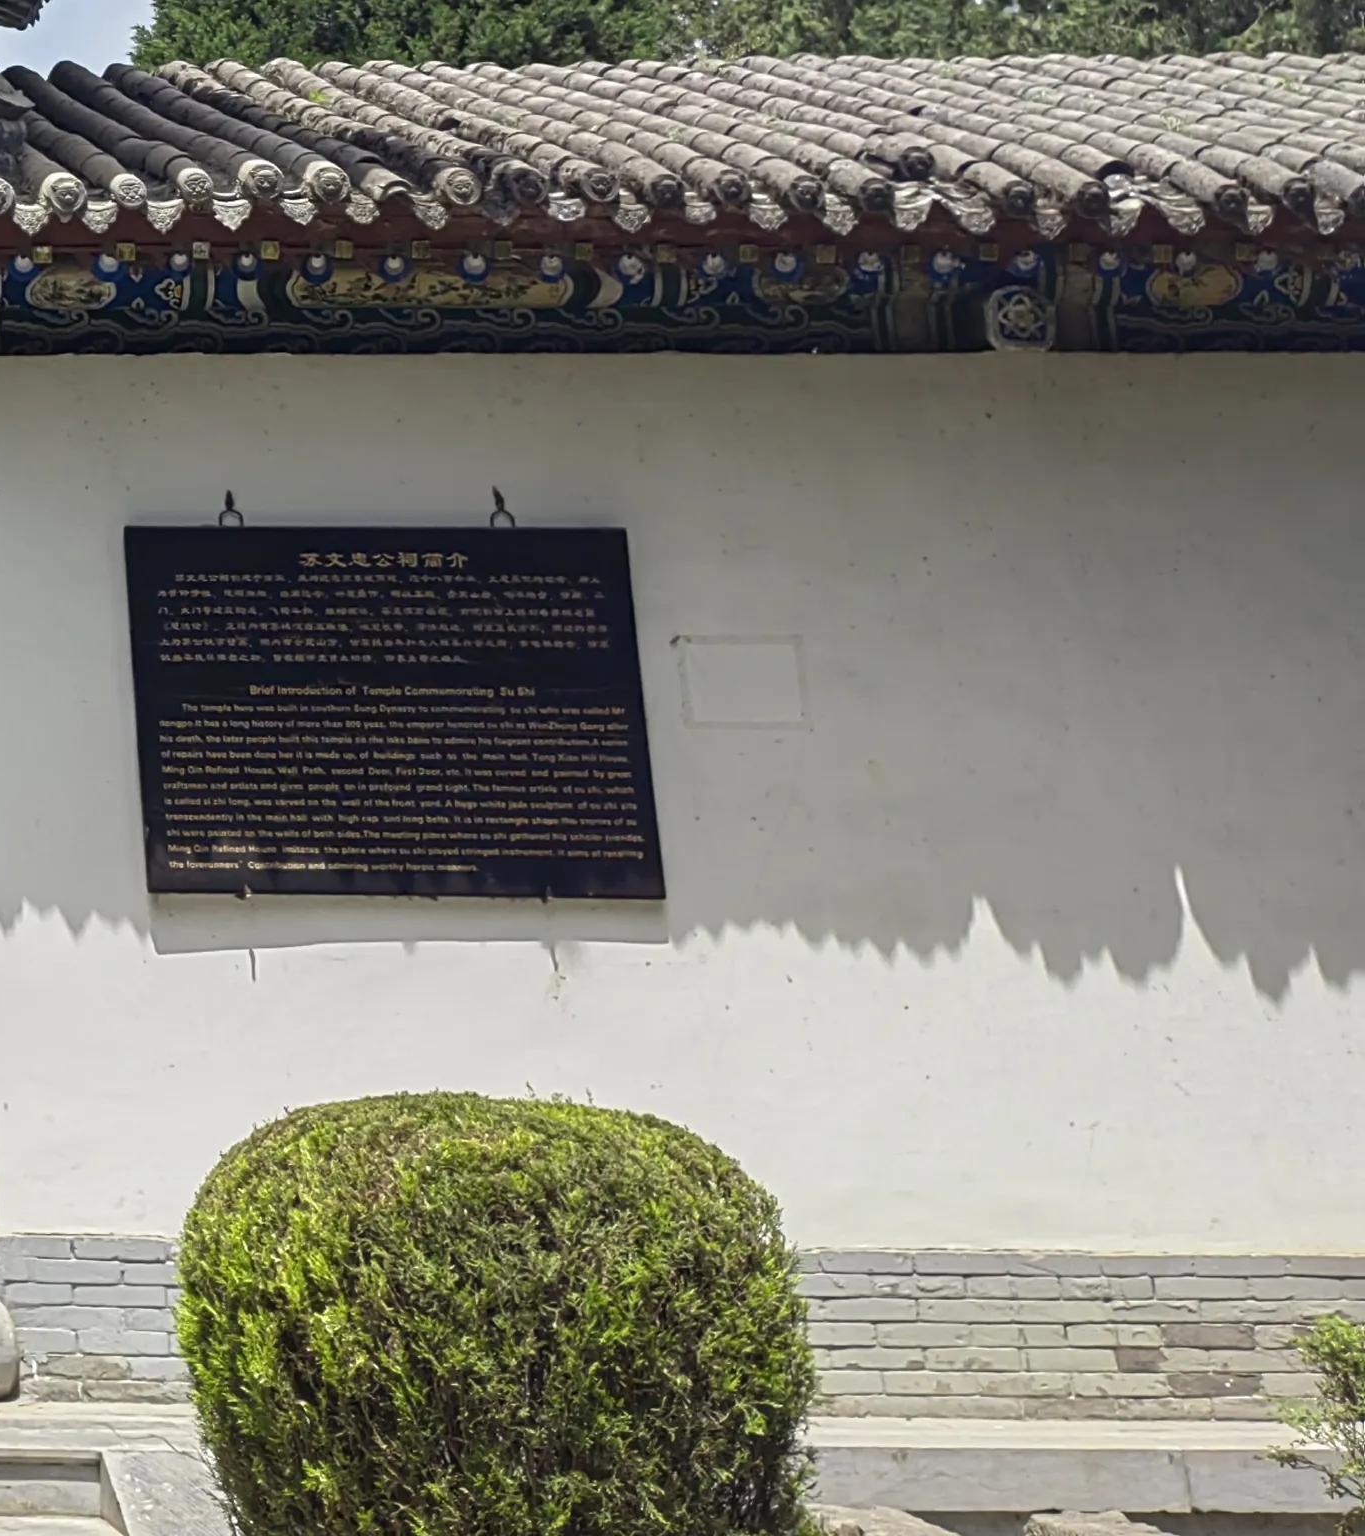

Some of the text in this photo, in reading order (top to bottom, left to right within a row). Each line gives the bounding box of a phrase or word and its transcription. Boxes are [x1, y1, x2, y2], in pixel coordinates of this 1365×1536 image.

[299, 551, 469, 569] 苏文忠公祠简介
